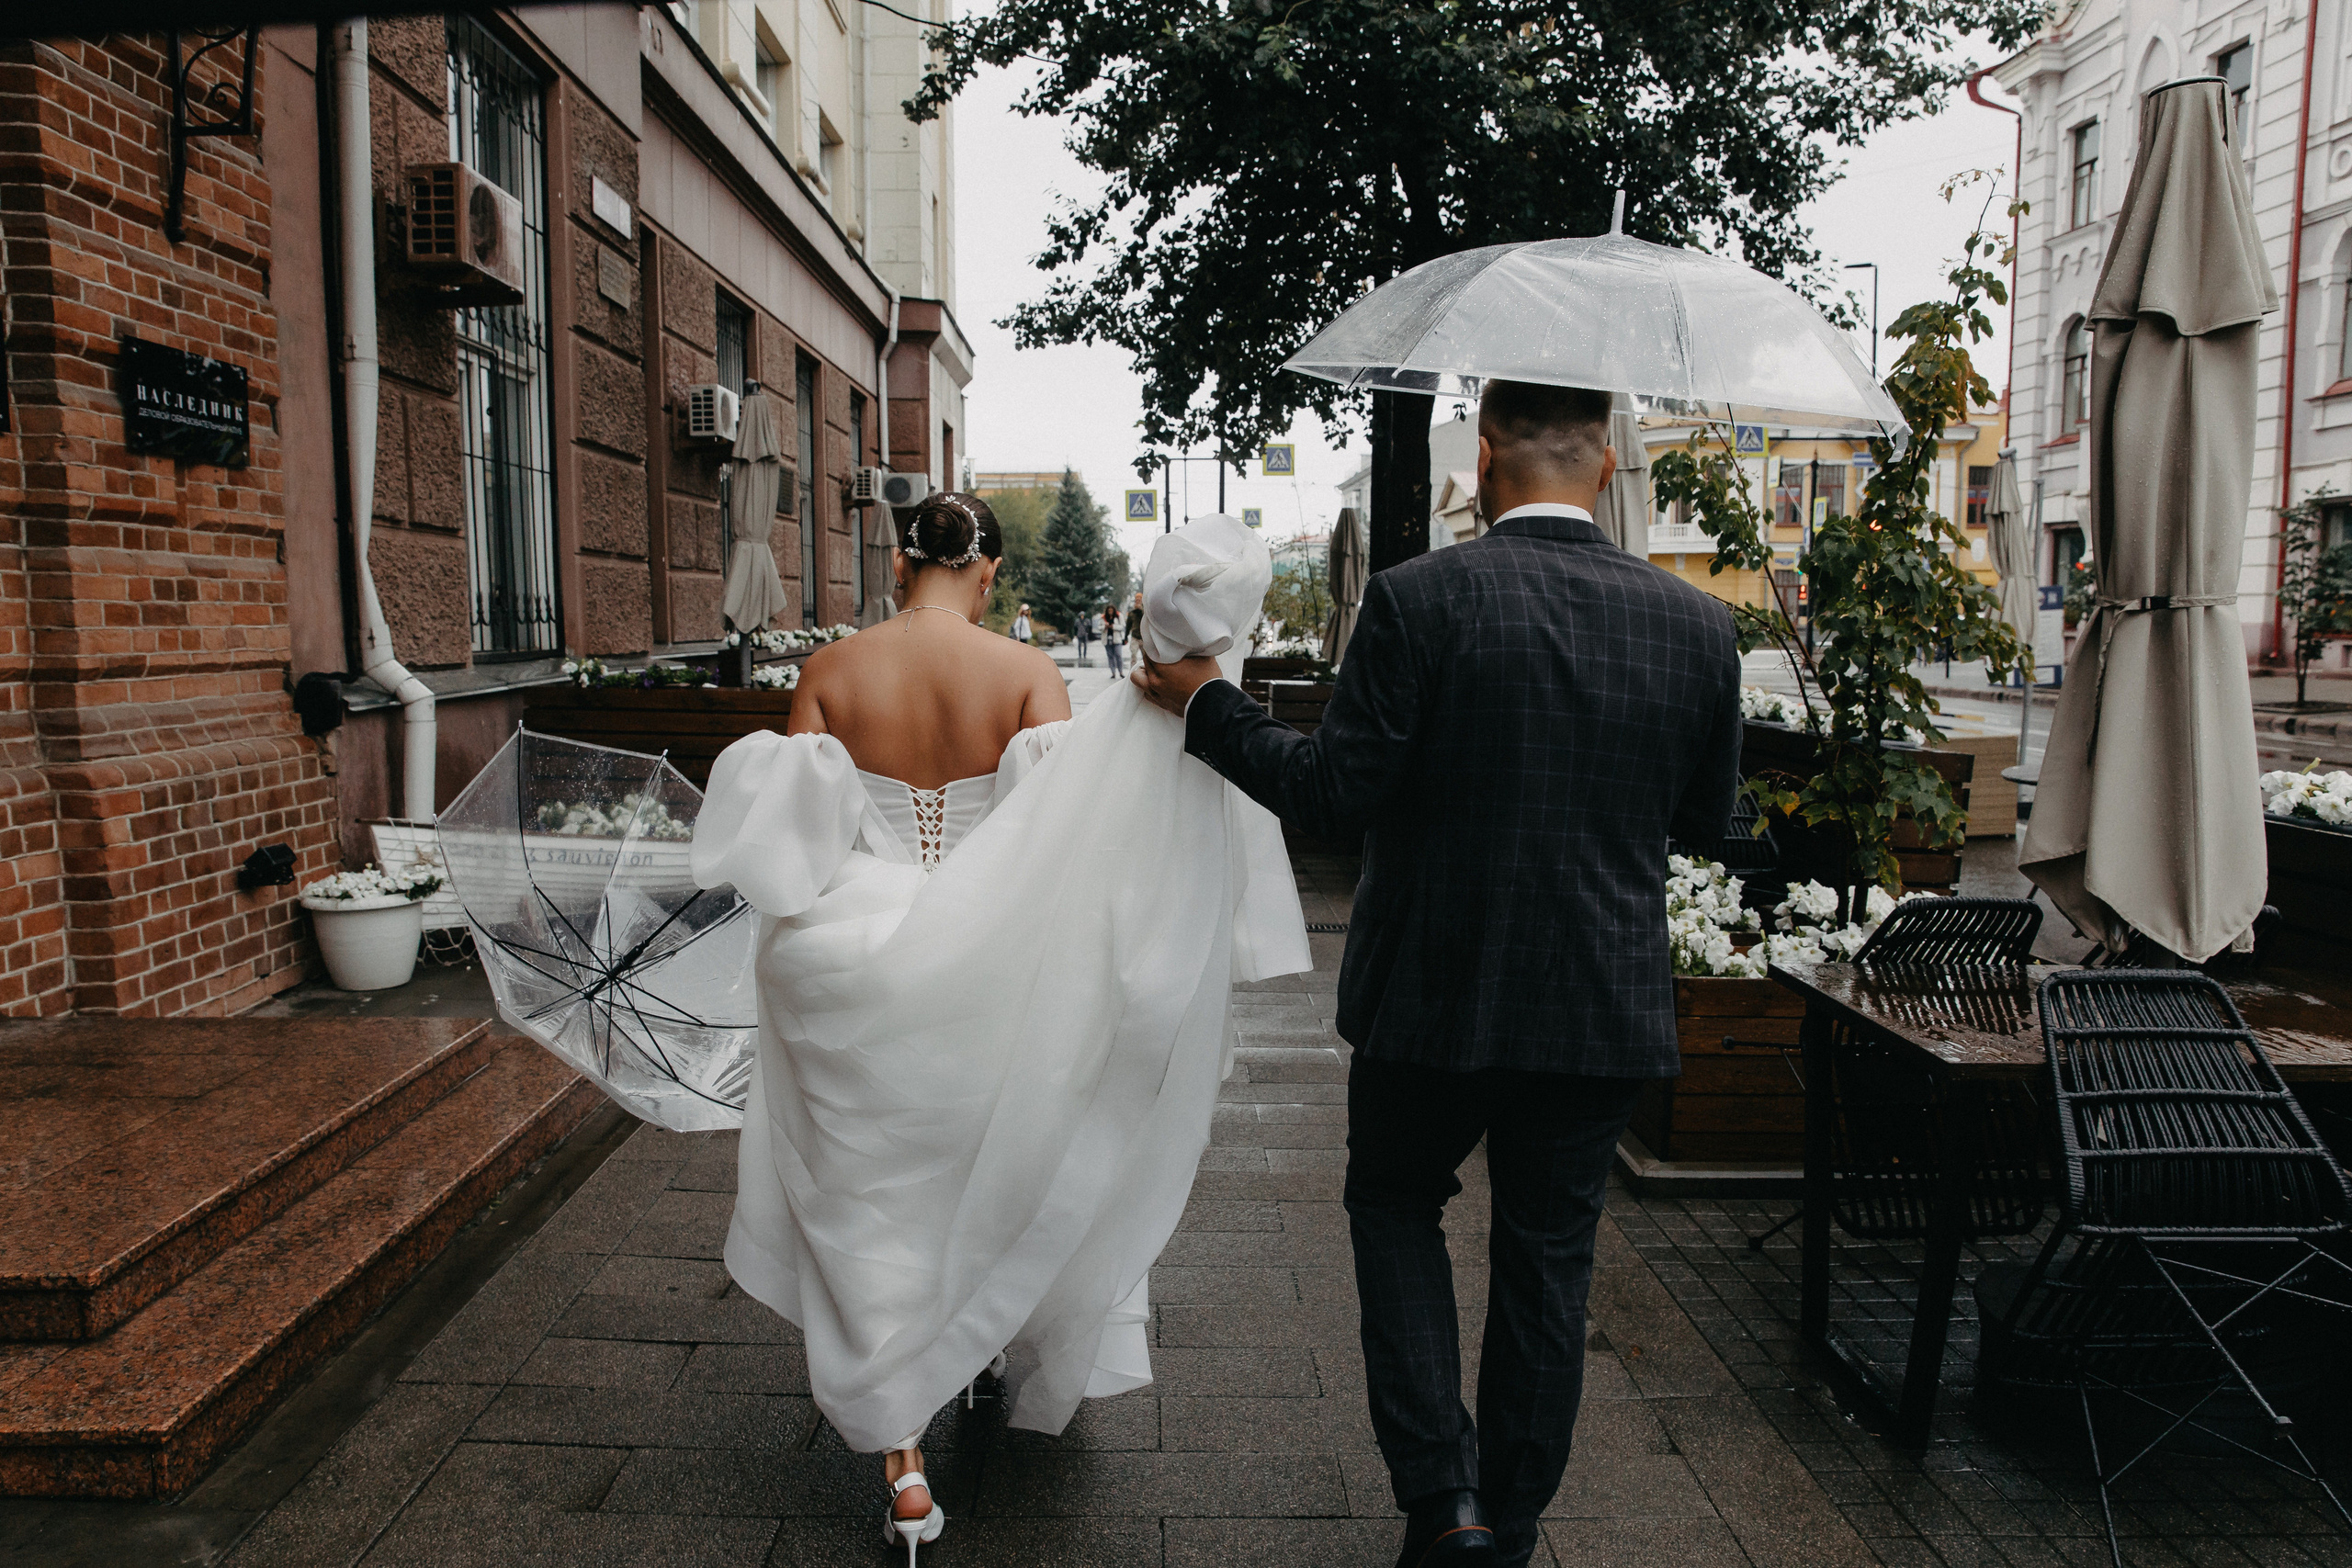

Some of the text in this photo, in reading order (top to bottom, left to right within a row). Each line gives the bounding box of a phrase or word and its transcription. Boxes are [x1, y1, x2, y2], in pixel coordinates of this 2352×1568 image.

[137, 384, 243, 422] НАСЛЕДНИК
[138, 407, 170, 421] ДЕЛОВОЙ
[546, 848, 653, 866] sauvigon
